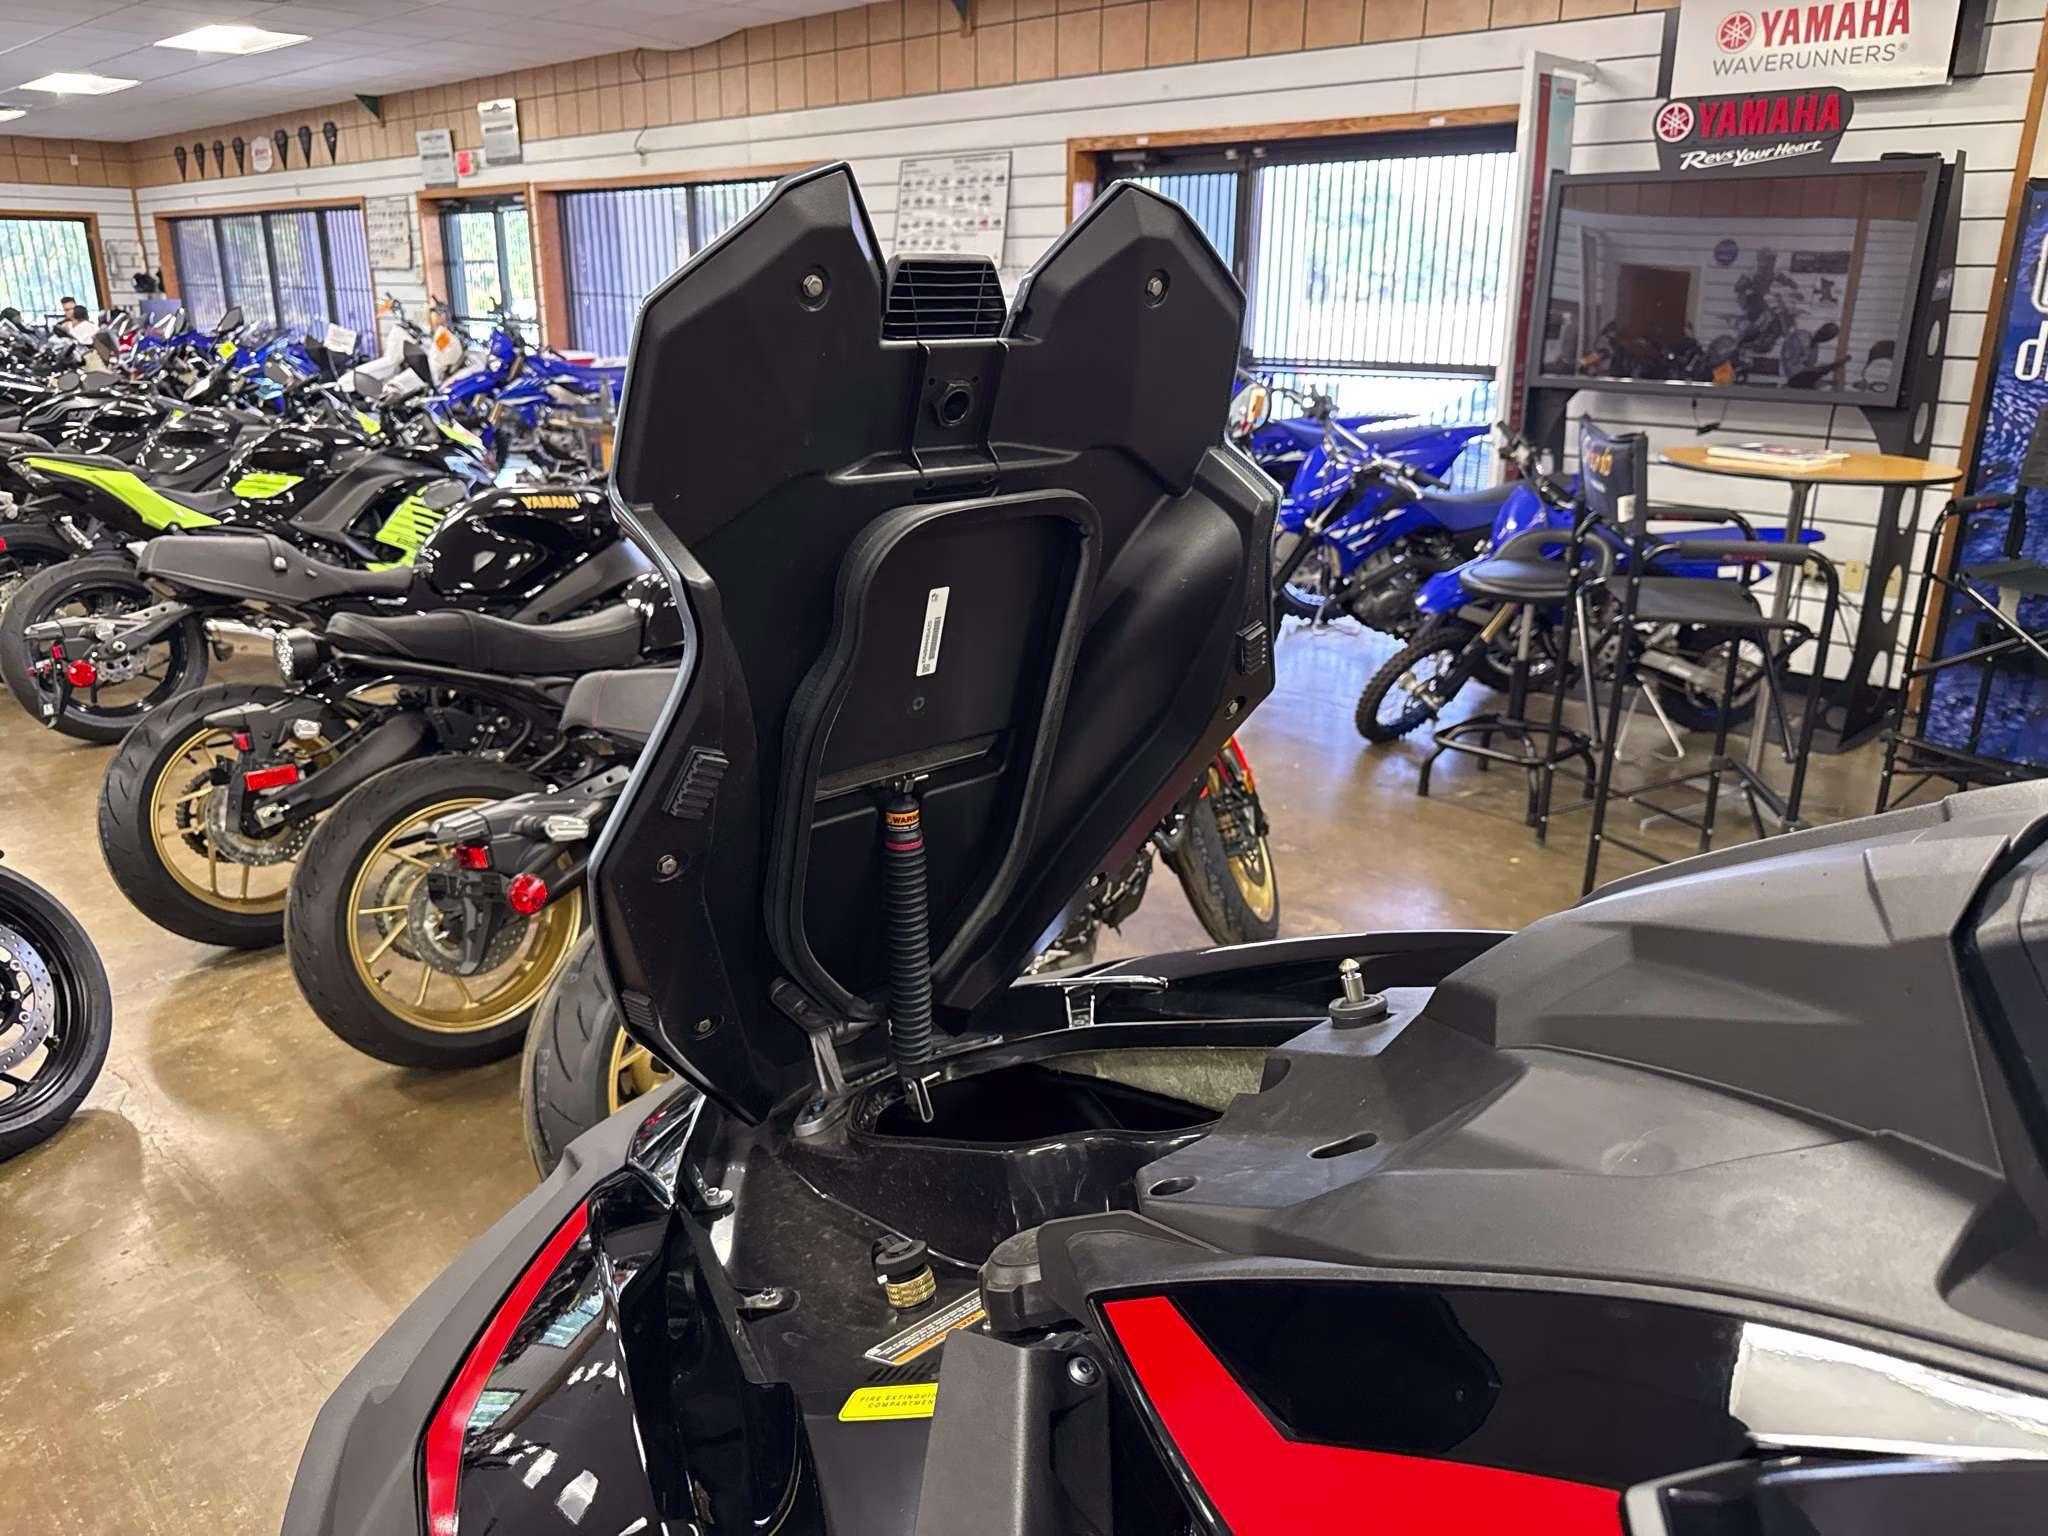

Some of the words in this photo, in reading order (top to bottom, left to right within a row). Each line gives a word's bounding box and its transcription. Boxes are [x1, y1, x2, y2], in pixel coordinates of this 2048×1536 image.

[1761, 0, 1910, 47] YAMAHA
[1699, 93, 1841, 139] YAMAHA
[520, 495, 580, 509] YAMAHA
